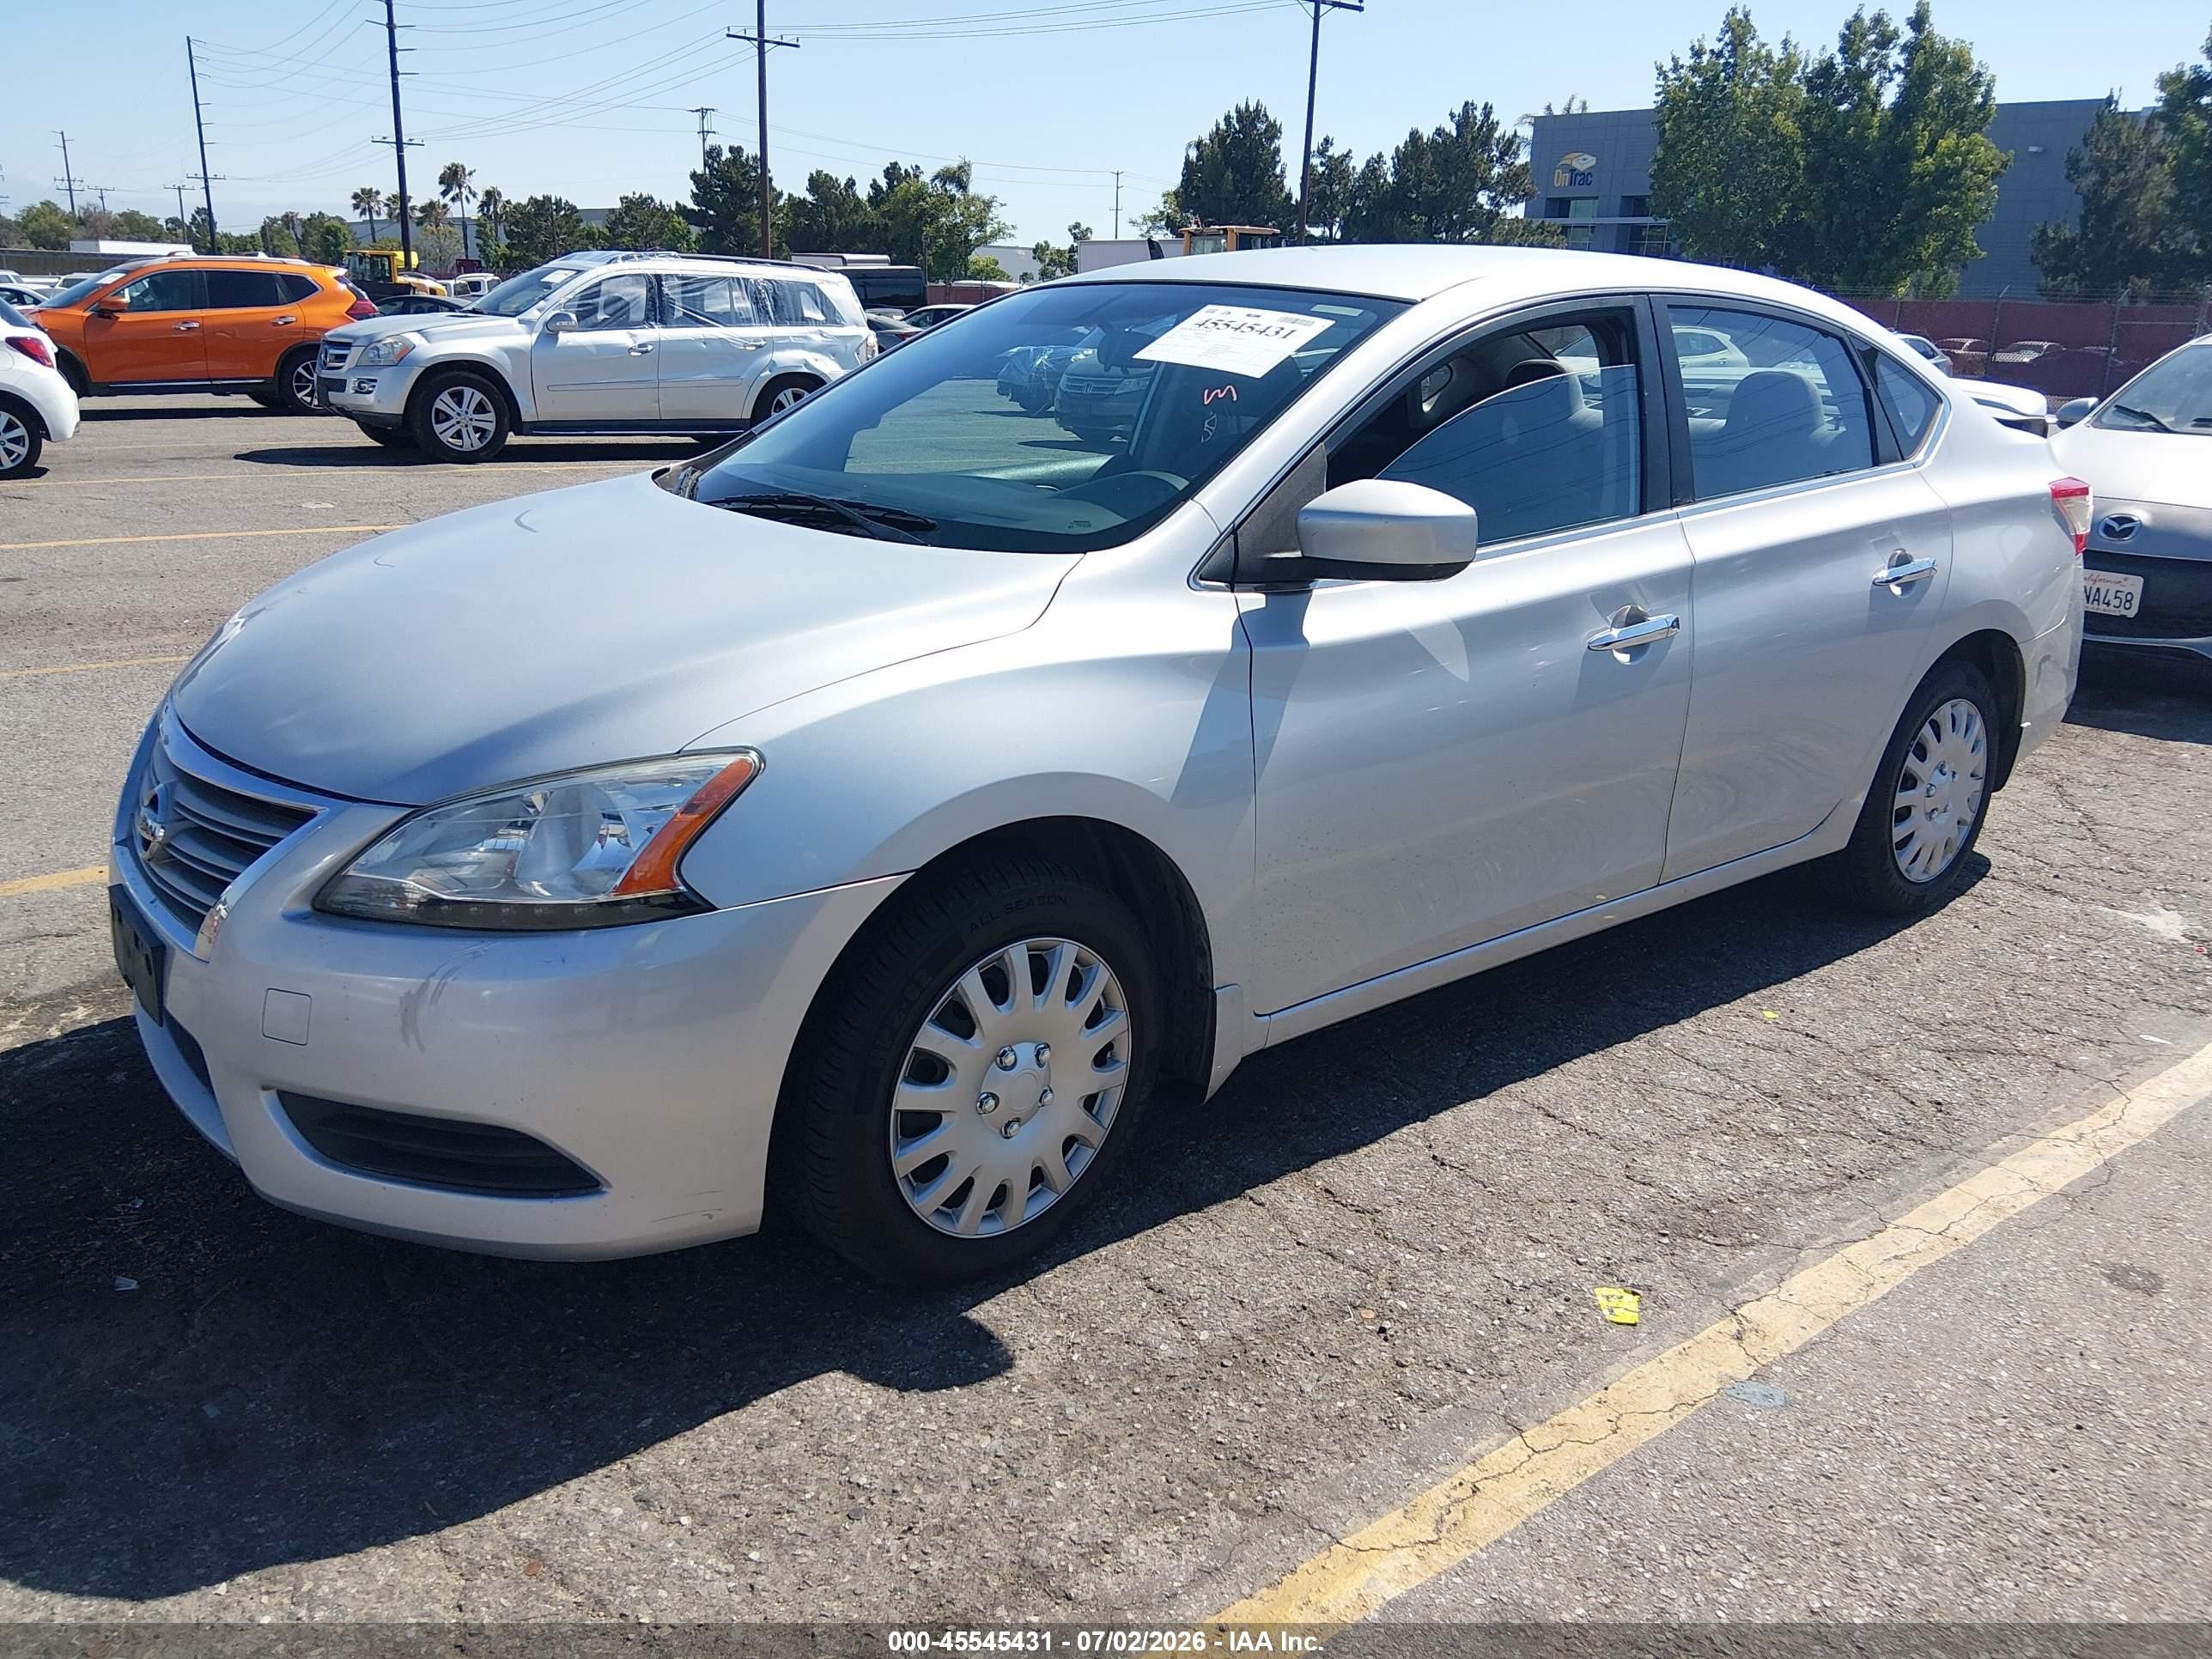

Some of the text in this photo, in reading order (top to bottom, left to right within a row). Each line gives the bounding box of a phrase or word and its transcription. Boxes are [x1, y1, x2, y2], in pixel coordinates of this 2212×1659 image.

[1553, 168, 1594, 186] OnTrac
[1194, 318, 1297, 339] 45545431
[969, 894, 1067, 935] ALL SEASON
